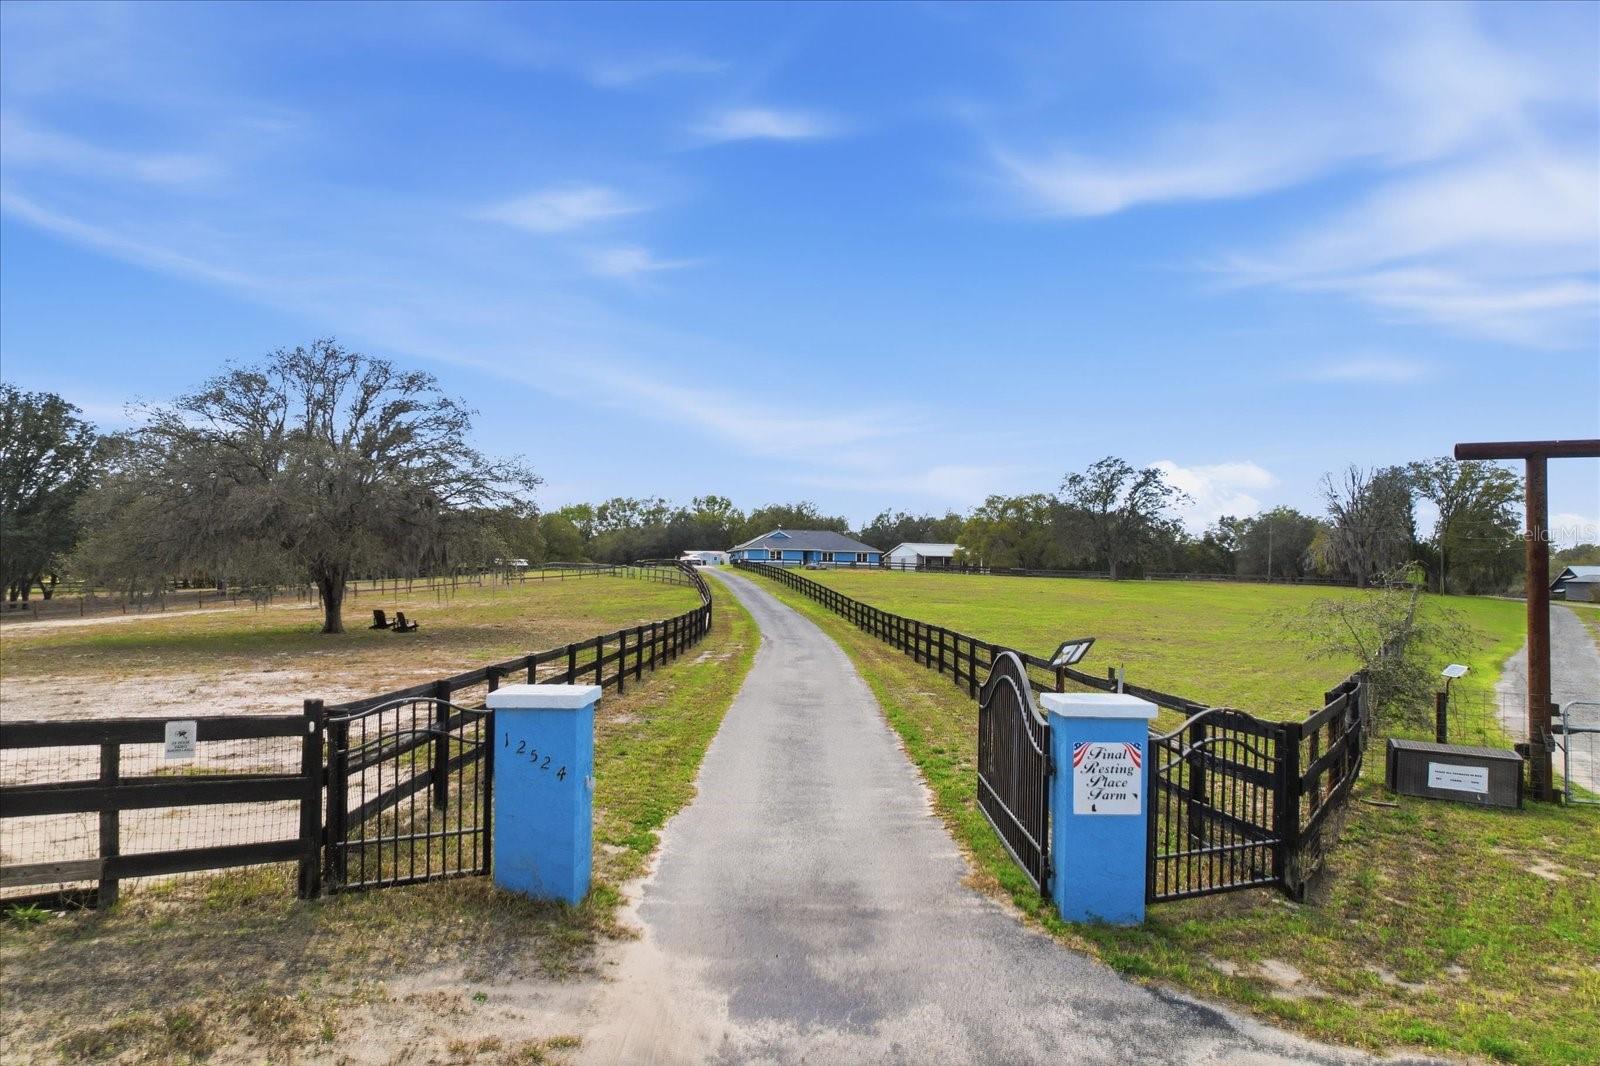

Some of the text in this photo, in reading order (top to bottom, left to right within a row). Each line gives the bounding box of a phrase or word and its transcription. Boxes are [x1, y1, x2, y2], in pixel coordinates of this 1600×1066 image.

[504, 732, 567, 781] 12524
[1087, 746, 1127, 760] Final
[1080, 761, 1134, 776] Resting
[1086, 775, 1128, 788] Place
[1087, 788, 1126, 800] Farm
